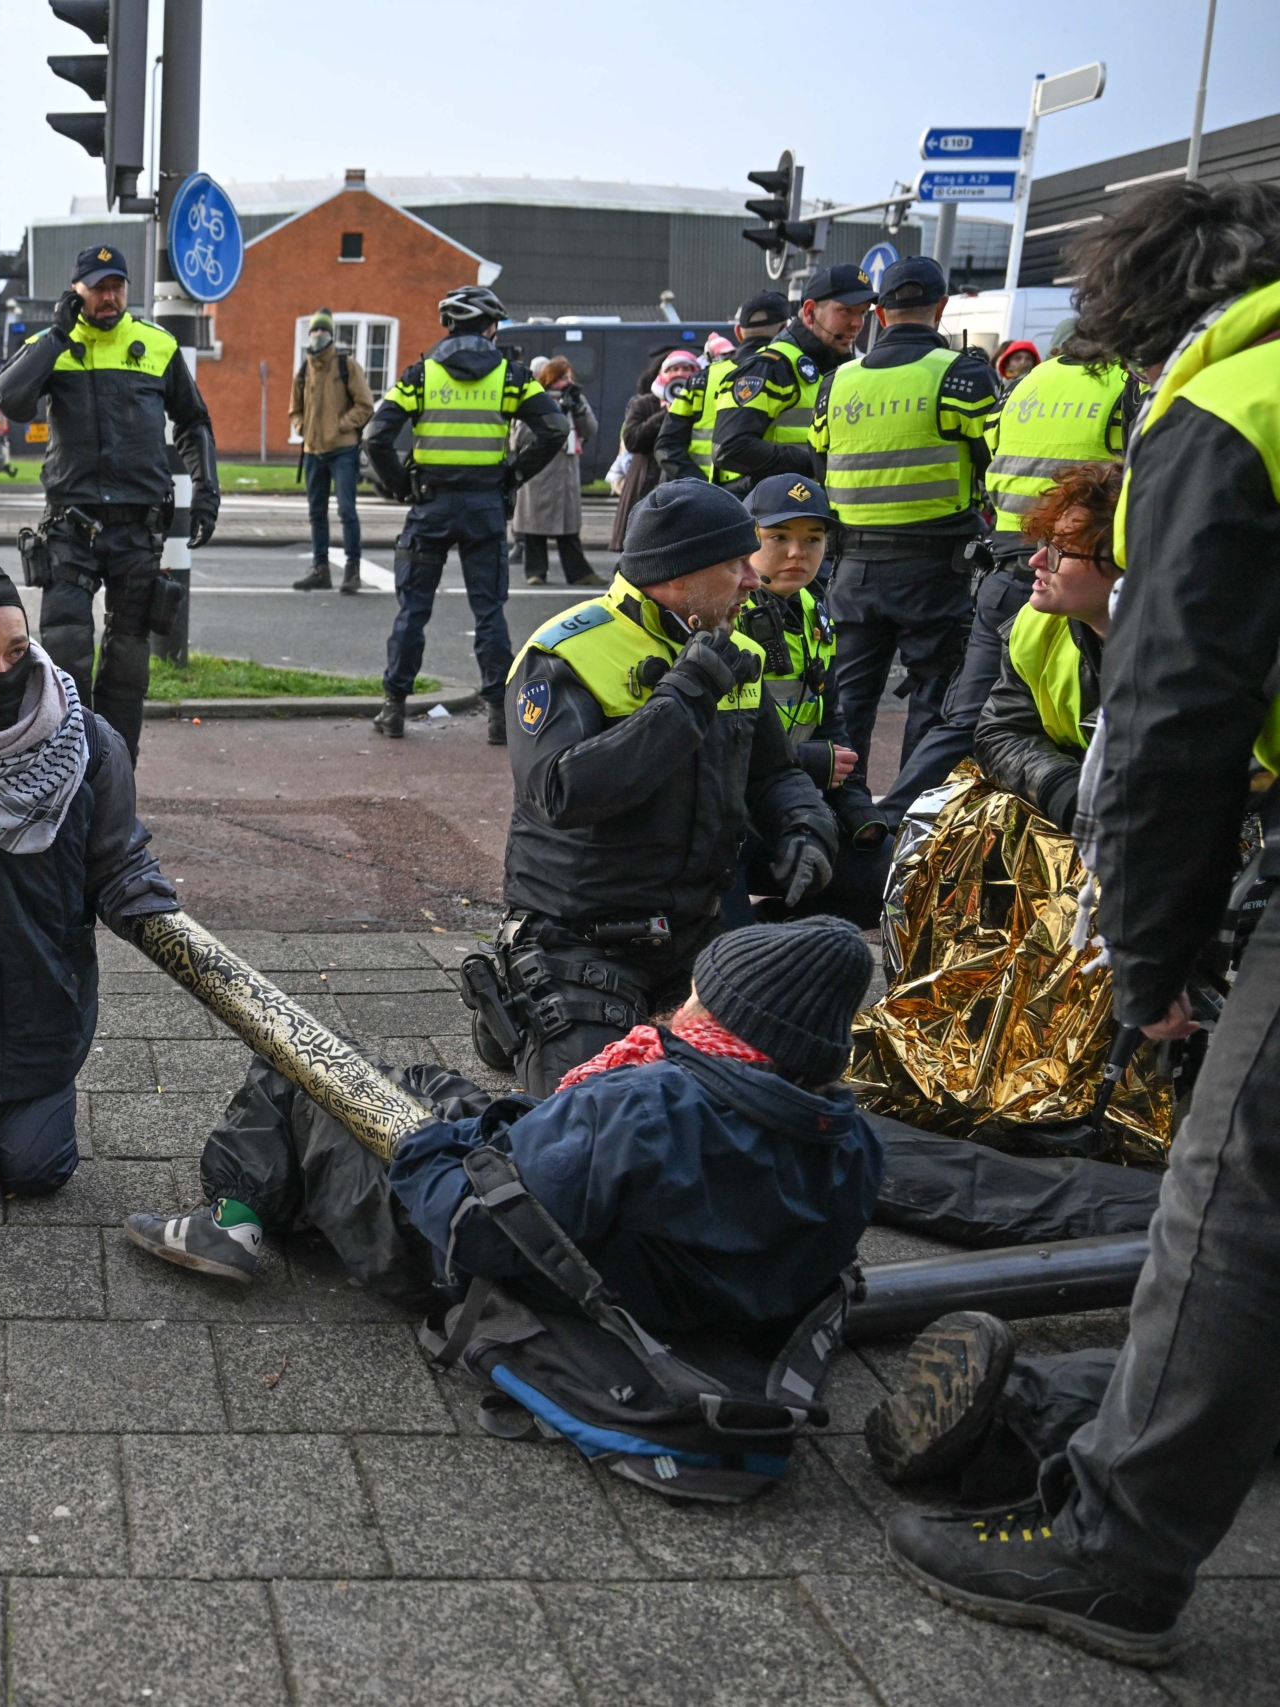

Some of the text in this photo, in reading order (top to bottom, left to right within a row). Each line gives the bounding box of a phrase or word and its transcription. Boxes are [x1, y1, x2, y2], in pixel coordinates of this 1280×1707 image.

[934, 175, 989, 186] Ring A29
[946, 188, 985, 196] Centrum
[832, 393, 928, 425] POLITIE
[1006, 394, 1102, 424] POLITIE
[560, 613, 591, 631] GC
